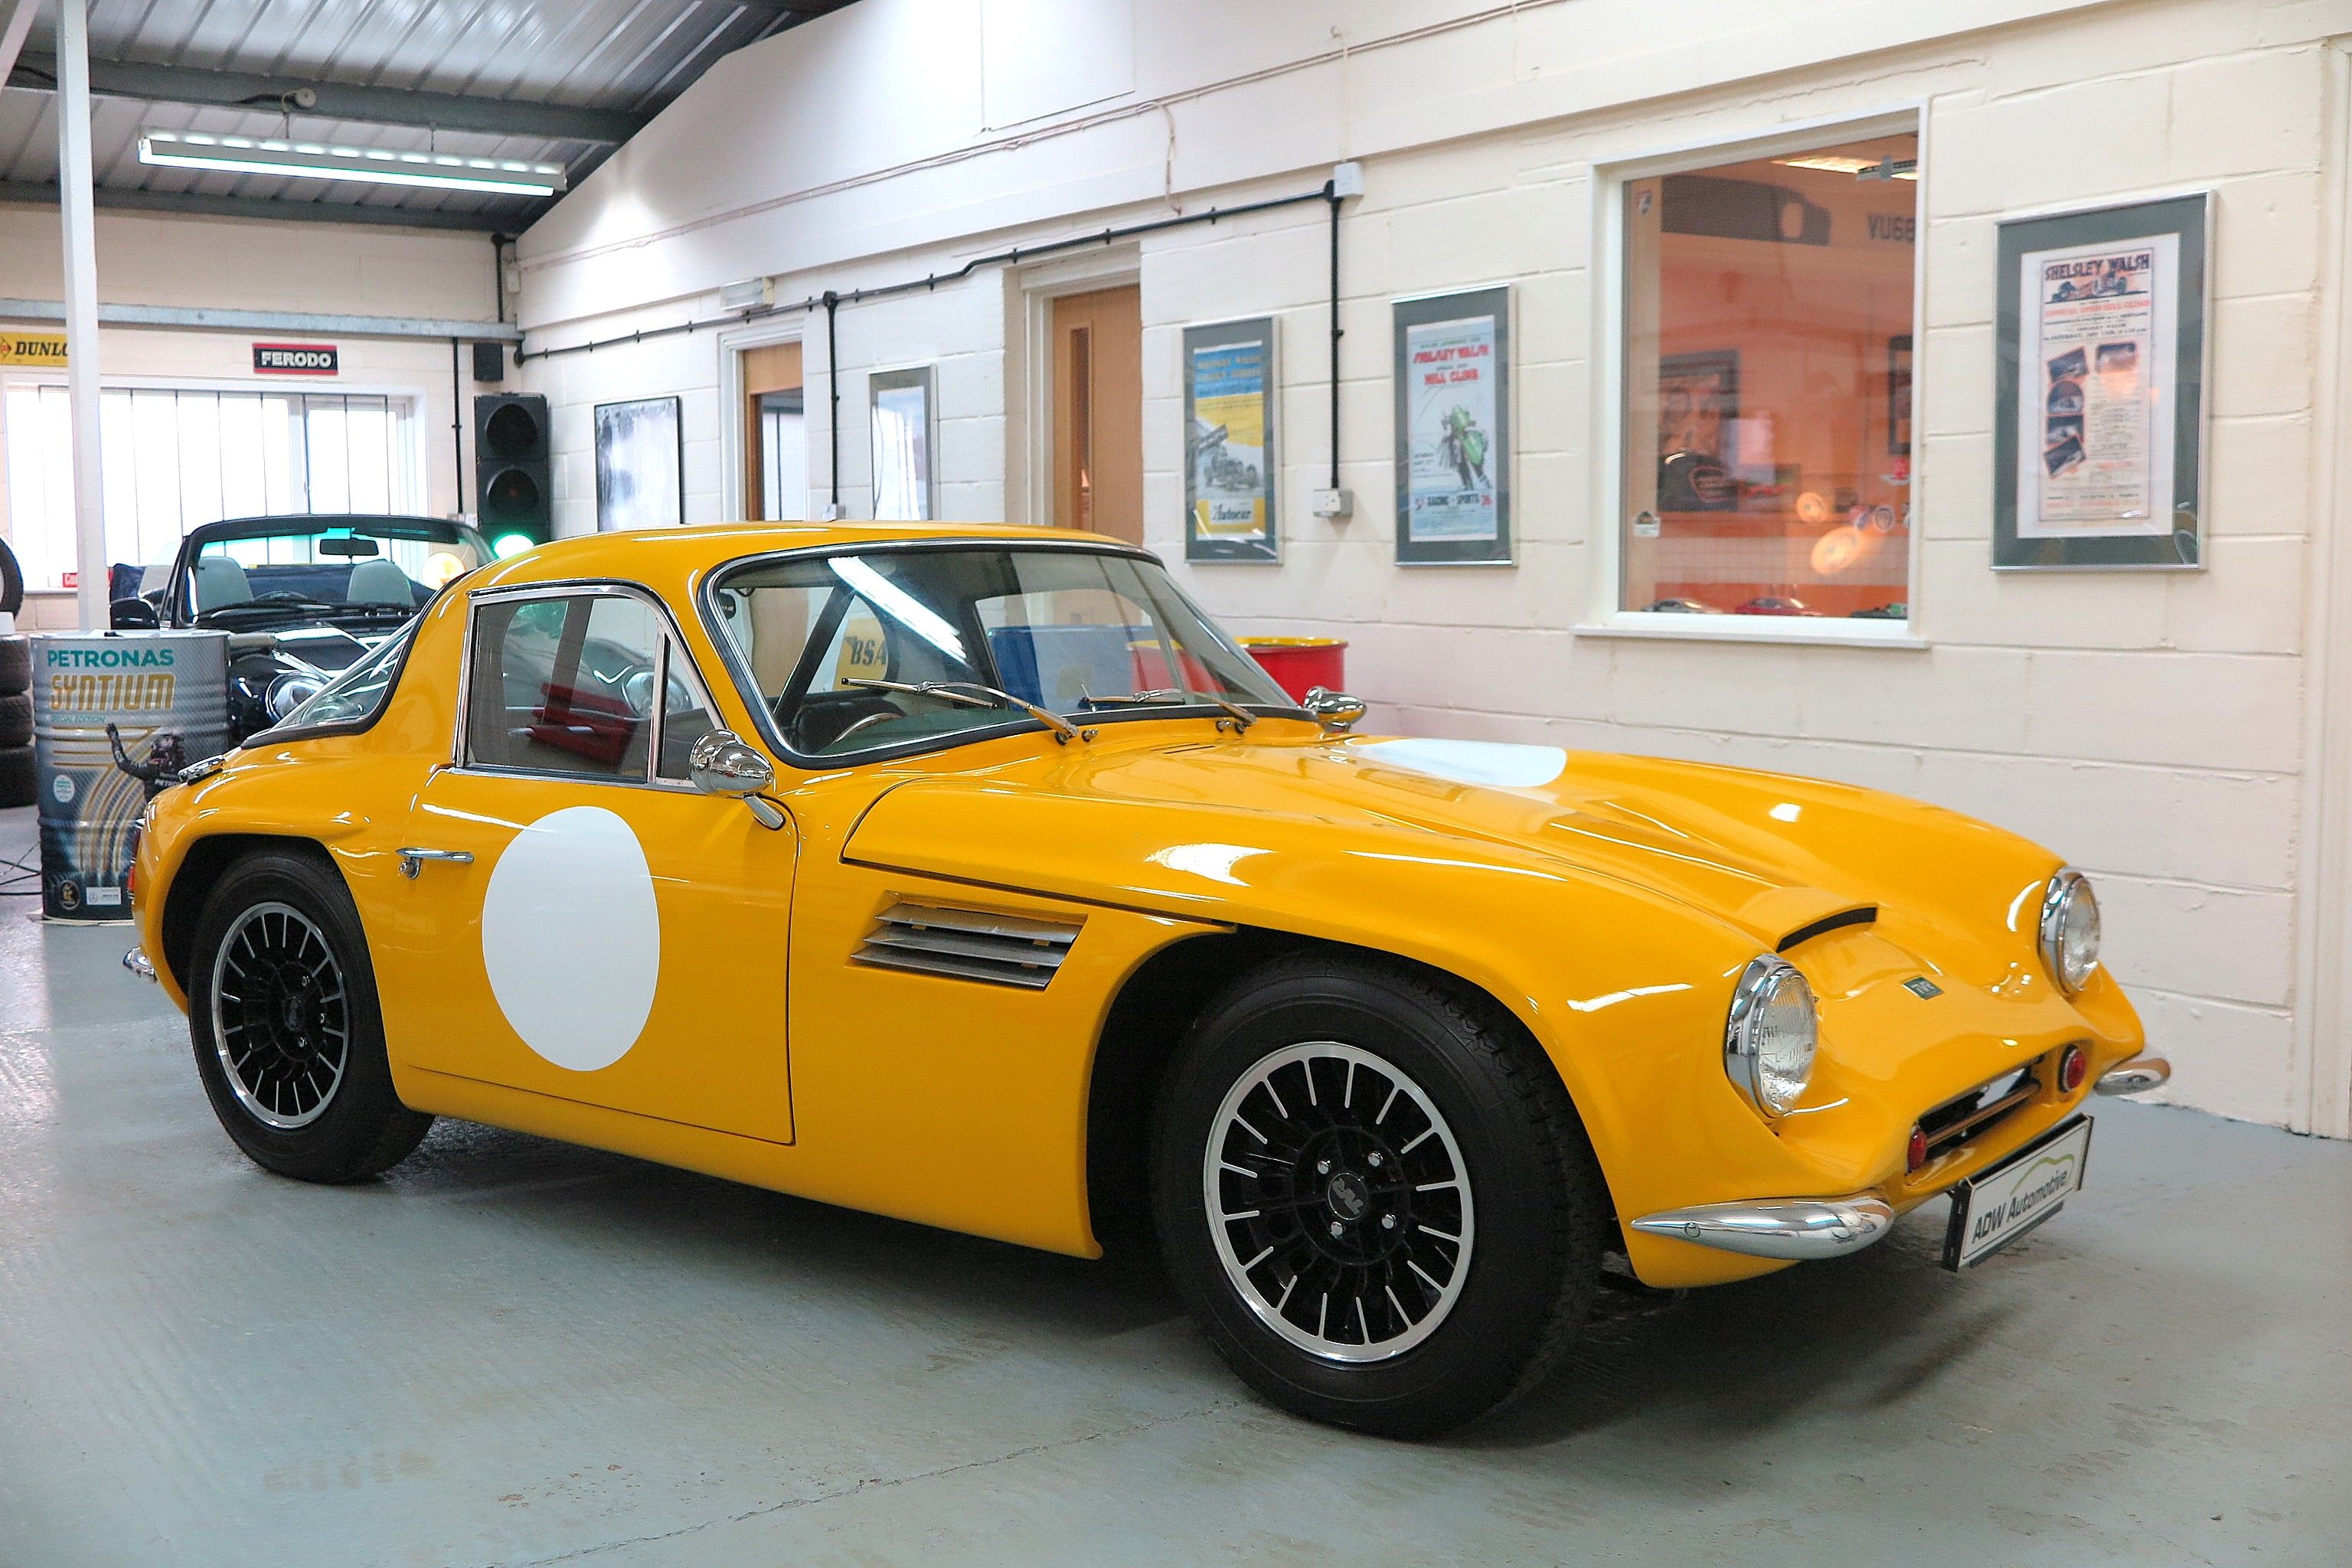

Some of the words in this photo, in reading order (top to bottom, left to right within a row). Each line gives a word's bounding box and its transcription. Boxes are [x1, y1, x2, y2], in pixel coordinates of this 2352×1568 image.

[2045, 260, 2104, 281] SHELSLEY
[261, 351, 332, 368] FERODO
[47, 648, 175, 668] PETRONAS
[849, 637, 887, 666] BSA
[50, 673, 177, 710] SYNTIUM
[1971, 1202, 2007, 1244] ADW
[2006, 1169, 2067, 1223] Automotive
